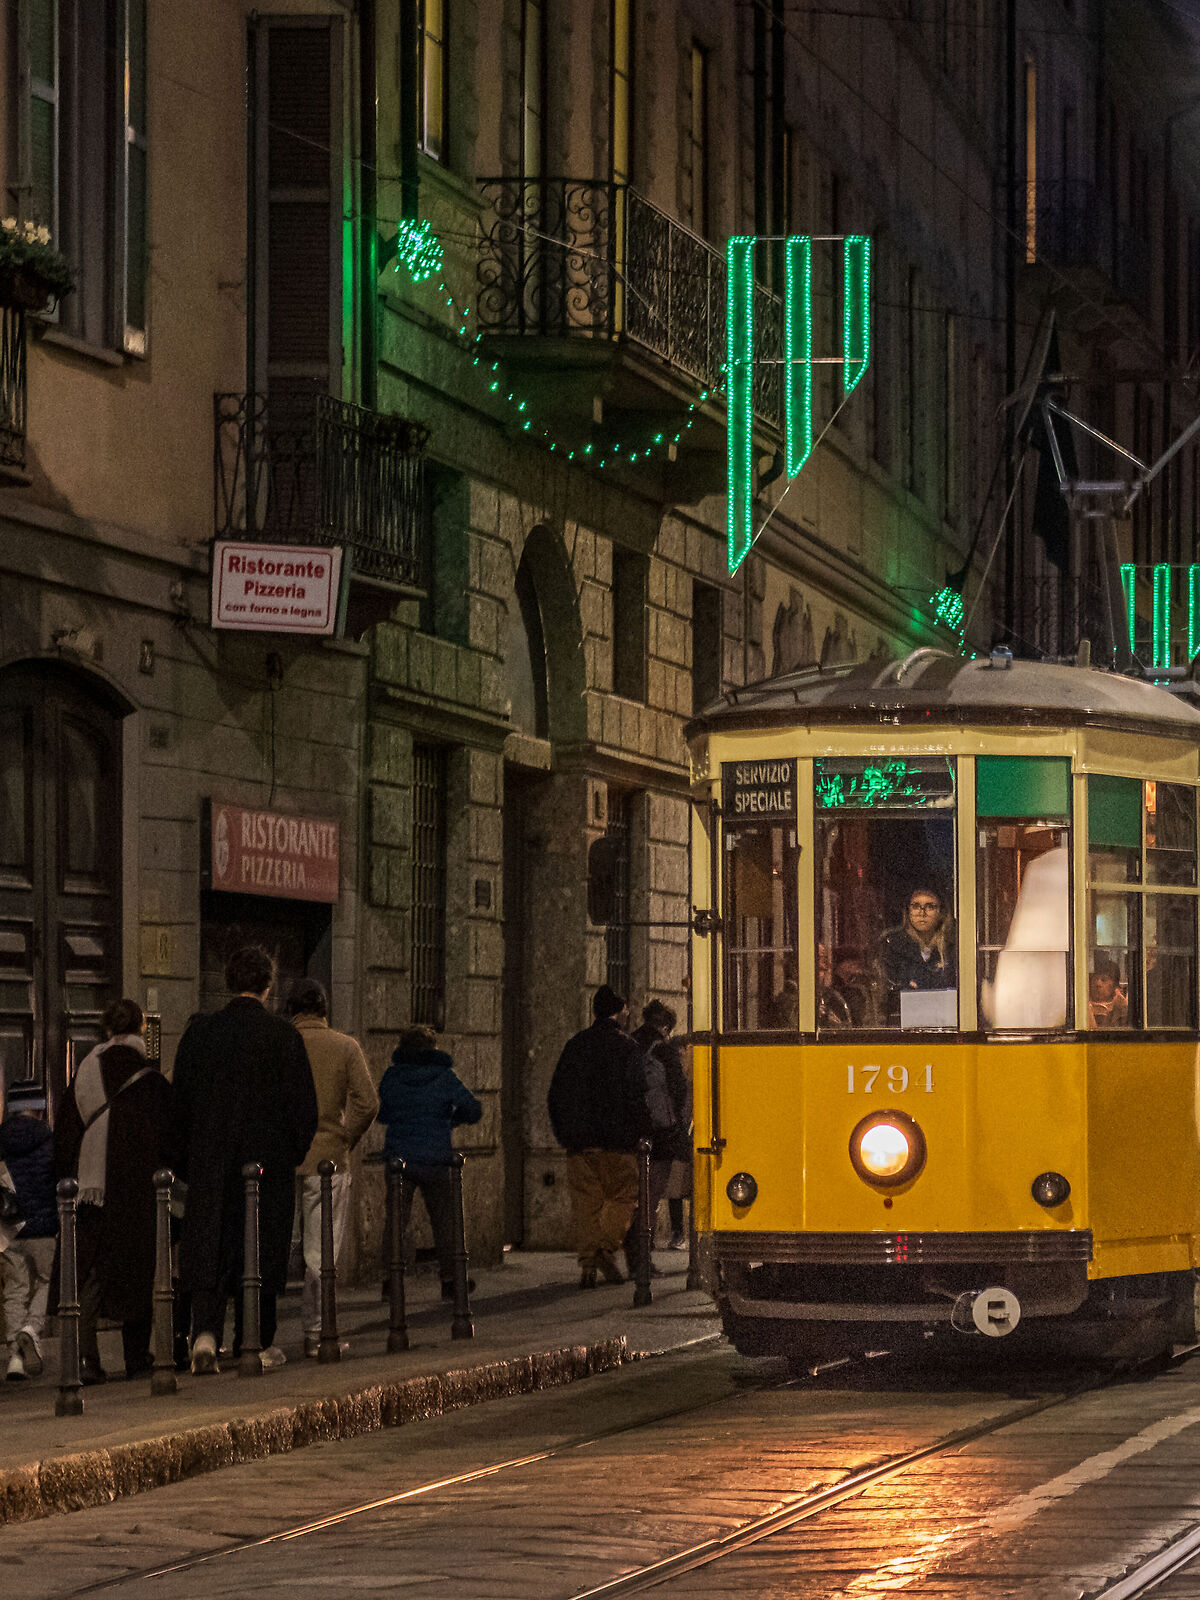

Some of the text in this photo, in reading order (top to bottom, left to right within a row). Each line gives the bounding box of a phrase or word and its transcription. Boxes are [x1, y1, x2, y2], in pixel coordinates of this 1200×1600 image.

[228, 555, 325, 579] Ristorante
[243, 580, 306, 599] Pizzeria
[225, 604, 246, 612] con
[250, 604, 280, 615] forno
[290, 606, 322, 618] legna
[736, 764, 790, 785] SERVIZIO
[735, 790, 792, 813] SPECIALE
[242, 812, 337, 860] RISTORANTE
[242, 855, 306, 889] PIZZERIA
[847, 1065, 935, 1093] 1794
